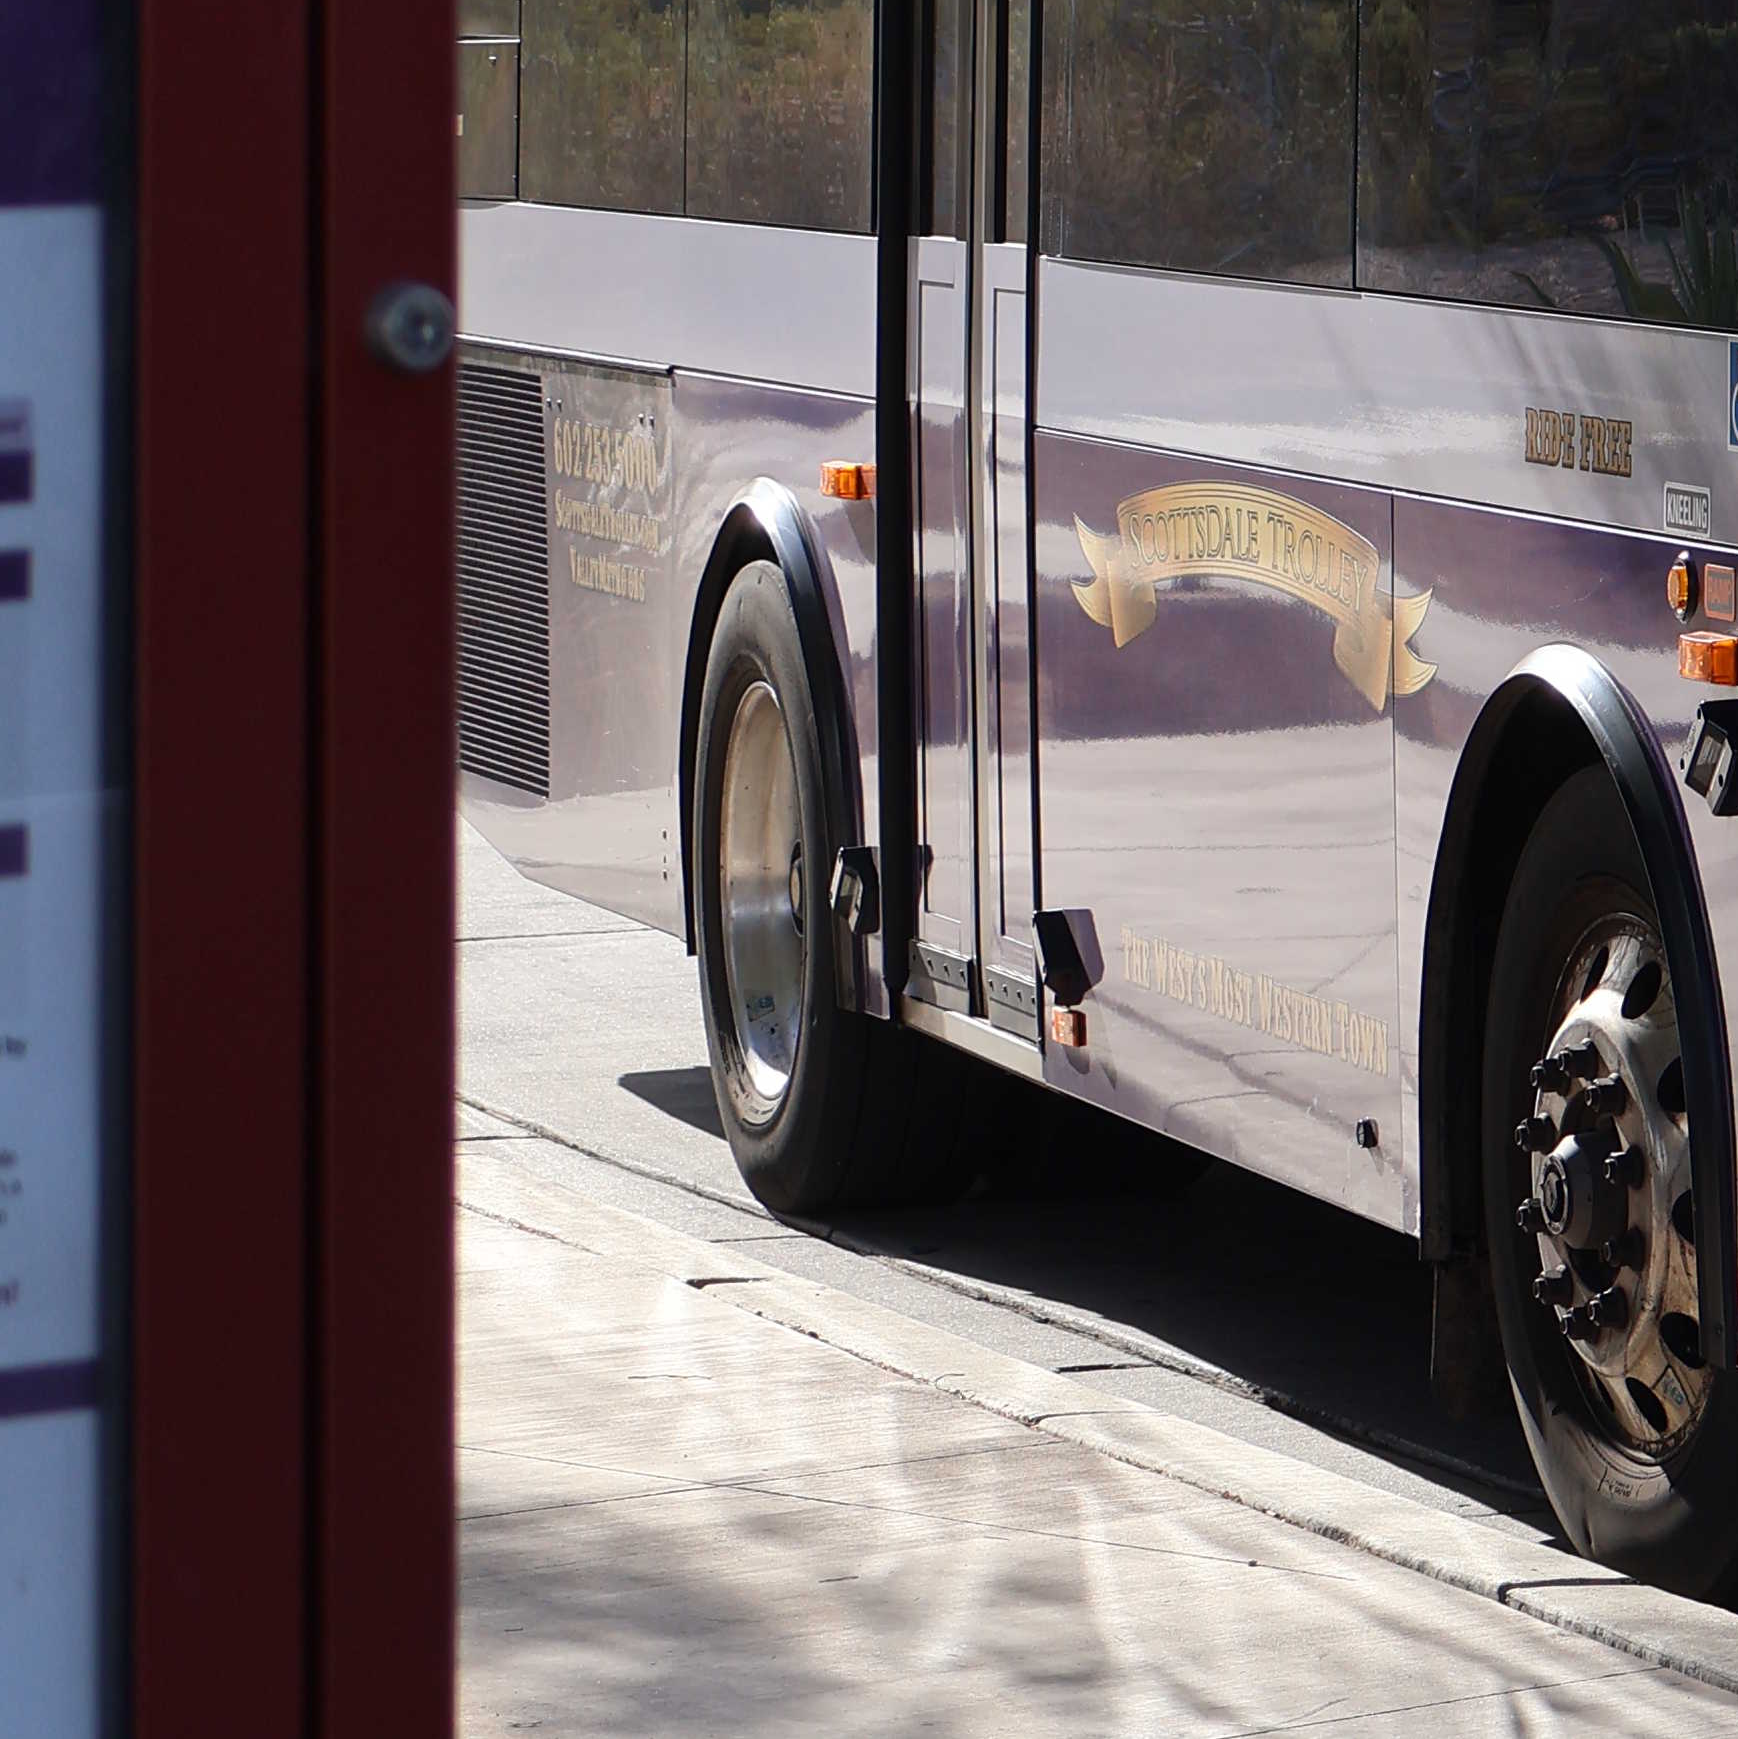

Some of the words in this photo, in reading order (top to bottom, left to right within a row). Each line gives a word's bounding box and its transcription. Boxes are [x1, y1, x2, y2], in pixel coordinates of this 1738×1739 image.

[1525, 406, 1576, 470] RIDE
[1579, 413, 1633, 478] FREE
[1666, 491, 1709, 530] KNEELING
[1128, 504, 1261, 568] SCOTTSDALE
[1267, 510, 1370, 612] TROLLEY
